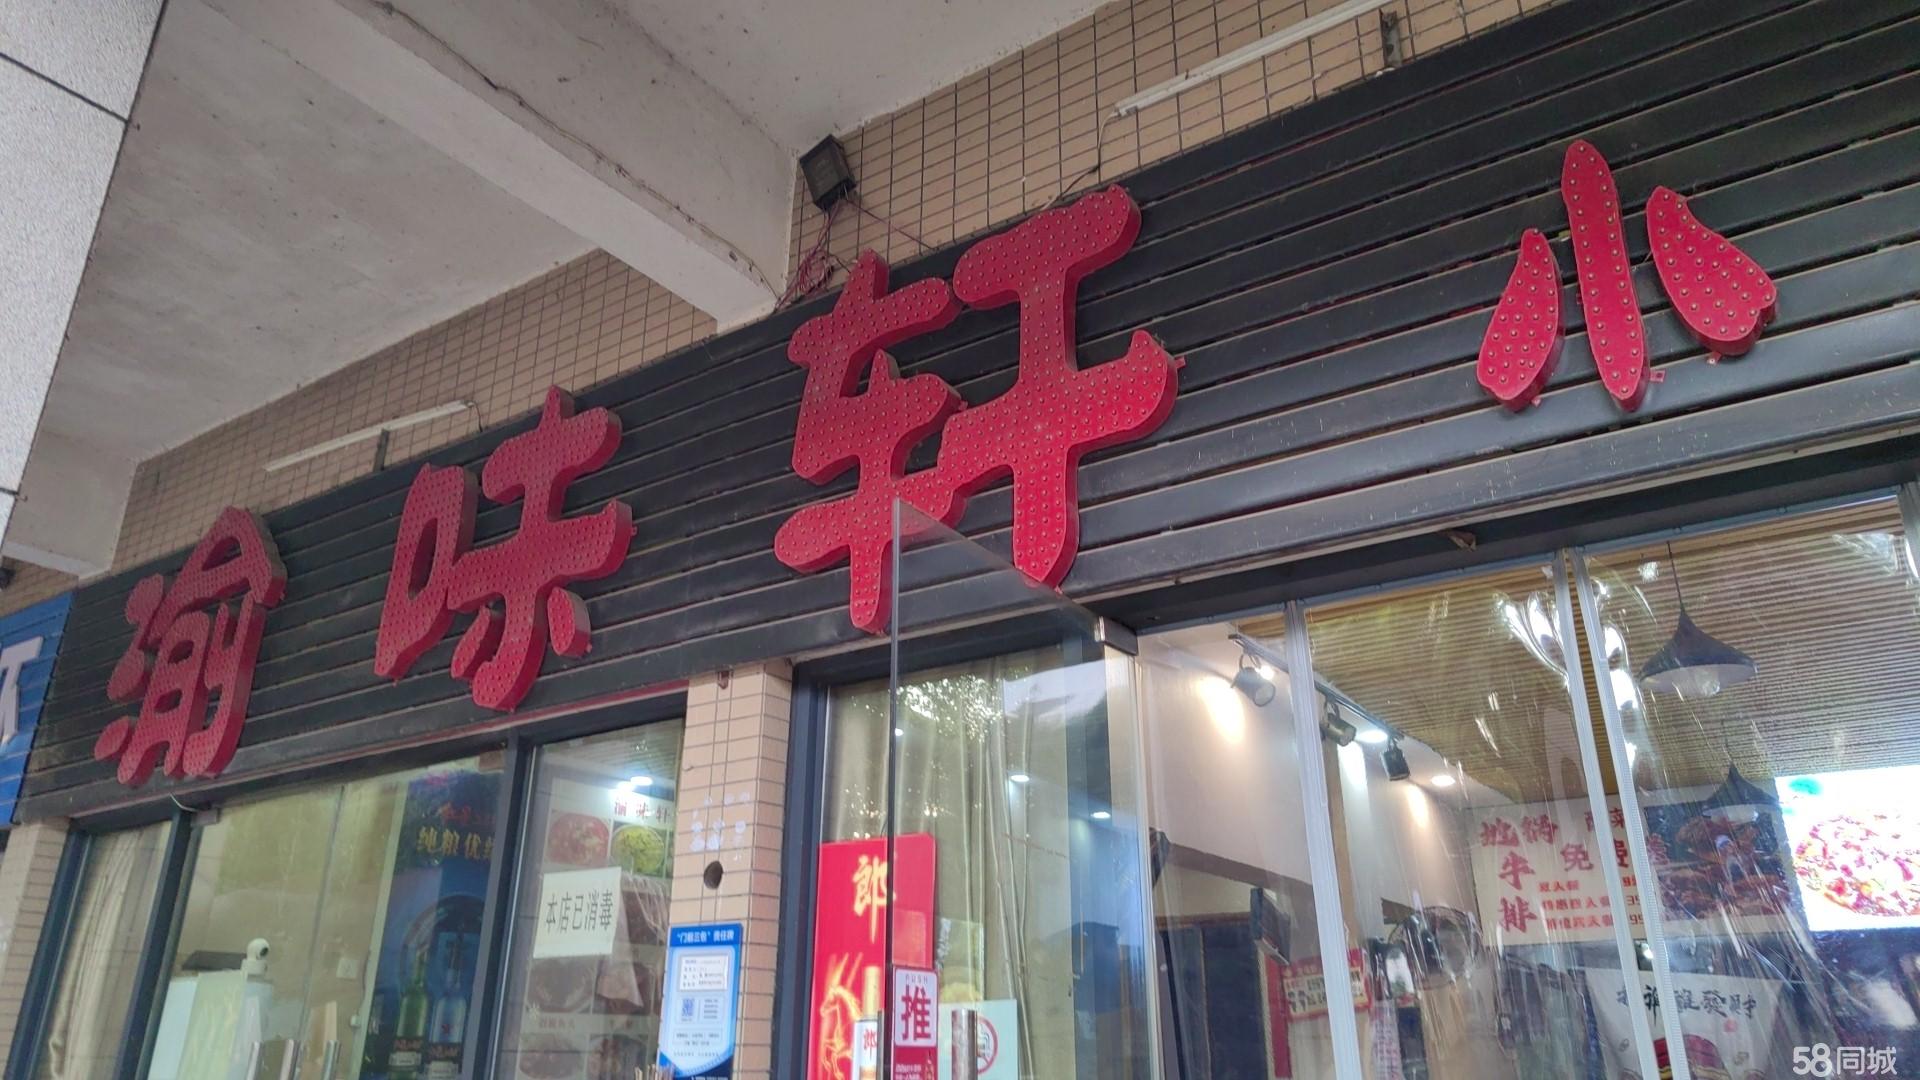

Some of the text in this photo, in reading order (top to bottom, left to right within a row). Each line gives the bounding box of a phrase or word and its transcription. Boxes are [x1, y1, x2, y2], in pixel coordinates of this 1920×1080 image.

[545, 889, 613, 934] 本店已消毒
[905, 973, 928, 985] PUSH
[901, 985, 931, 1041] 推
